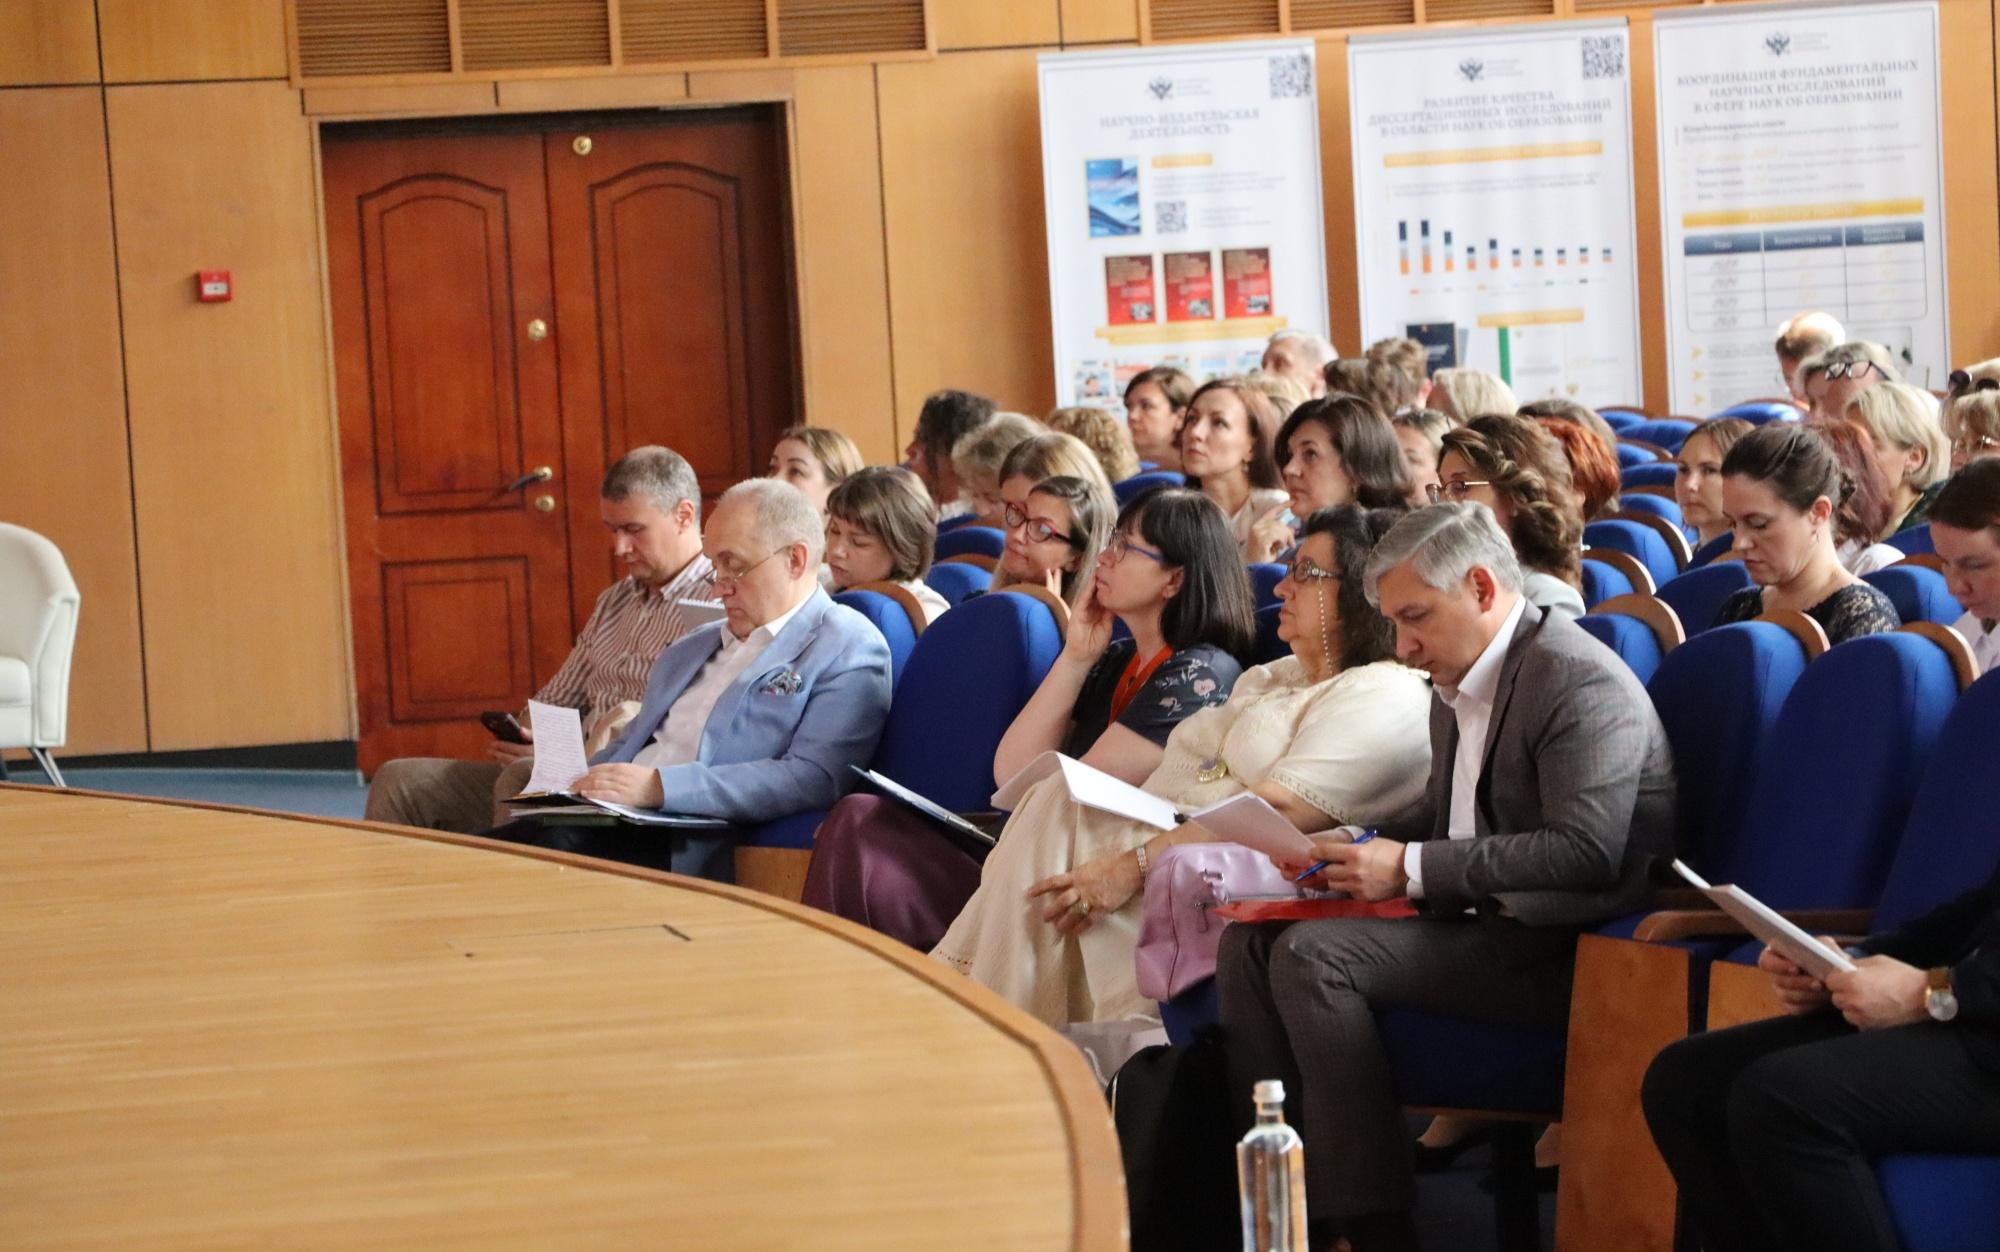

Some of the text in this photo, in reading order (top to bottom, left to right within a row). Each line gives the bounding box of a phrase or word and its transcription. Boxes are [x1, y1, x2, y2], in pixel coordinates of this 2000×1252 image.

[1677, 59, 1919, 87] КООРДИНАЦИЯ ФУНДАМЕНТАЛЬНЫХ
[1491, 90, 1555, 104] КАЧЕСТВА
[1709, 84, 1774, 99] НАУЧНЫХ
[1693, 89, 1903, 114] В СФЕРЕ НАУК ОБ ОБРАЗОВАНИИ
[1380, 126, 1388, 137] В
[1390, 122, 1449, 136] ОБЛАСТИ
[1453, 119, 1486, 133] НАУК
